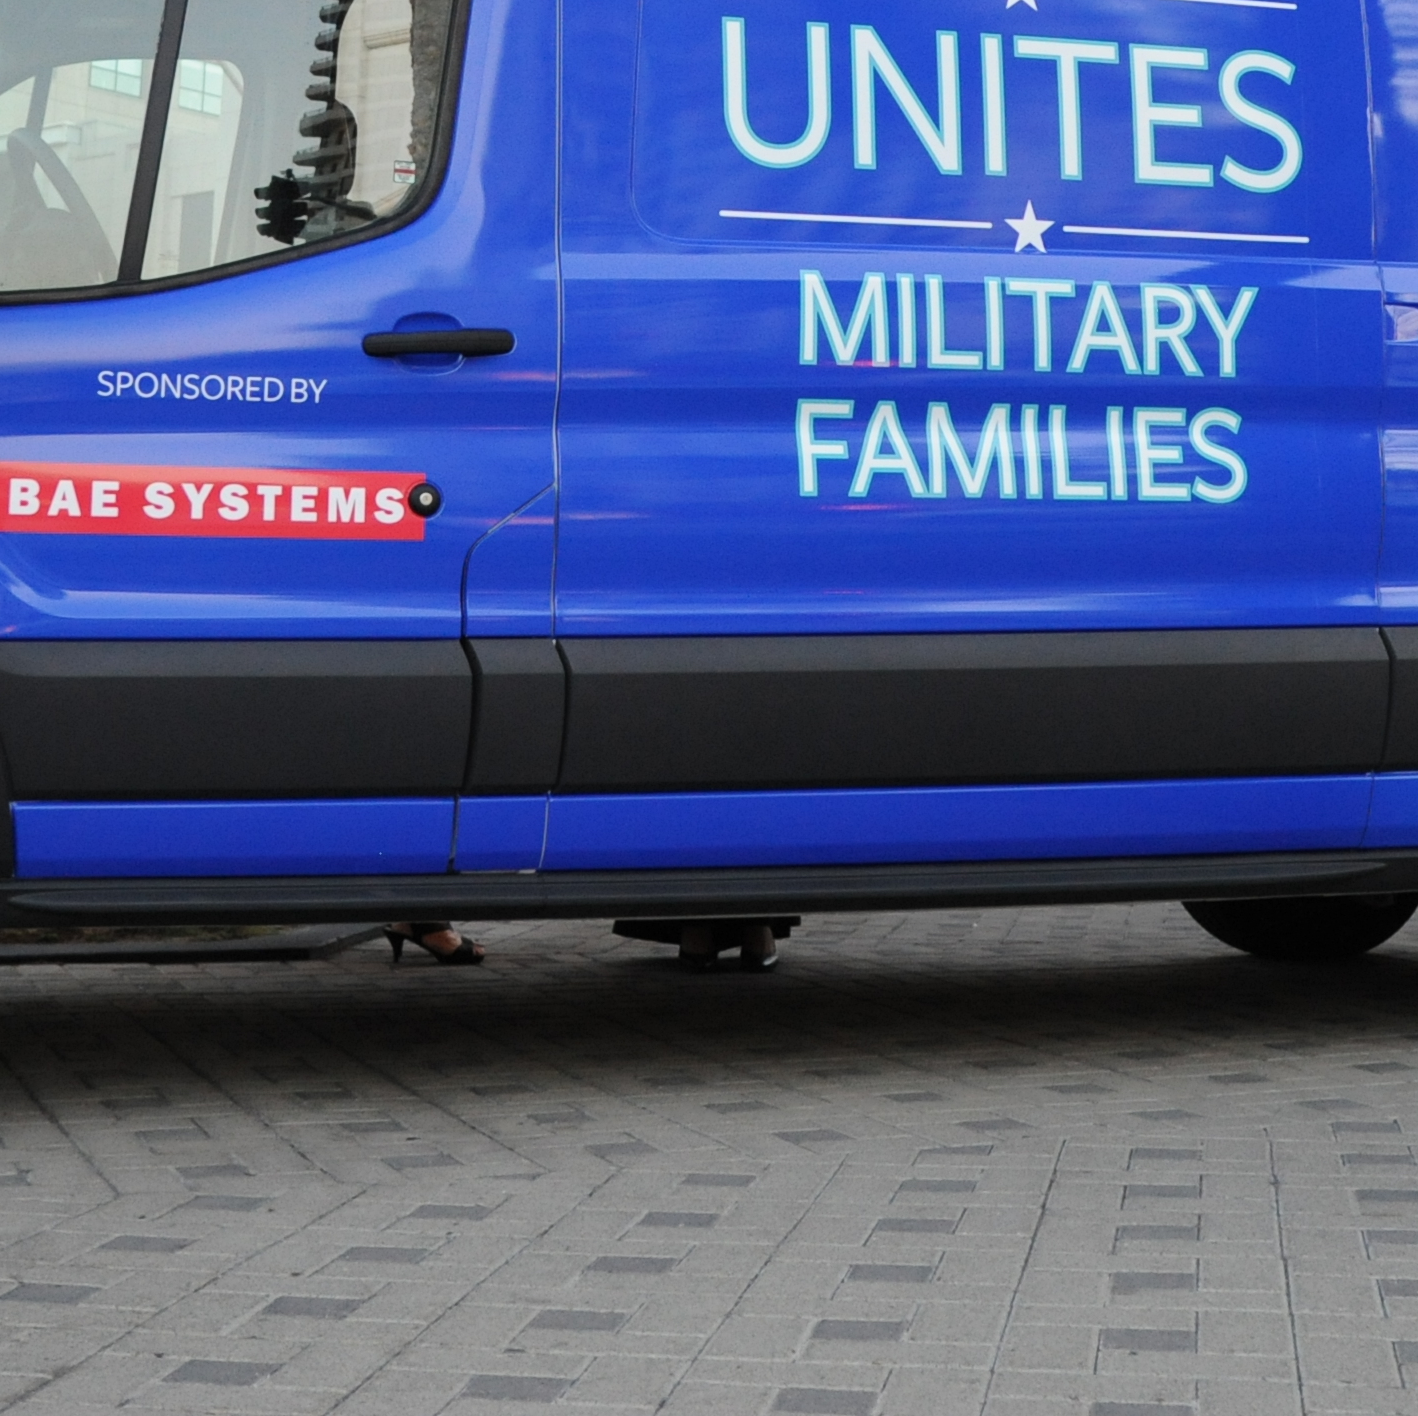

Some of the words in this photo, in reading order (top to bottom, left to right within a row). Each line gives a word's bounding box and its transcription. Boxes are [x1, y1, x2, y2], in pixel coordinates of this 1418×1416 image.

[721, 16, 1304, 193] UNITES
[798, 269, 1260, 378] MILITARY
[96, 370, 284, 403] SPONSORED
[290, 378, 328, 404] BY
[8, 477, 122, 518] BAE
[142, 481, 406, 524] SYSTEMS
[796, 399, 1249, 504] FAMILIES
